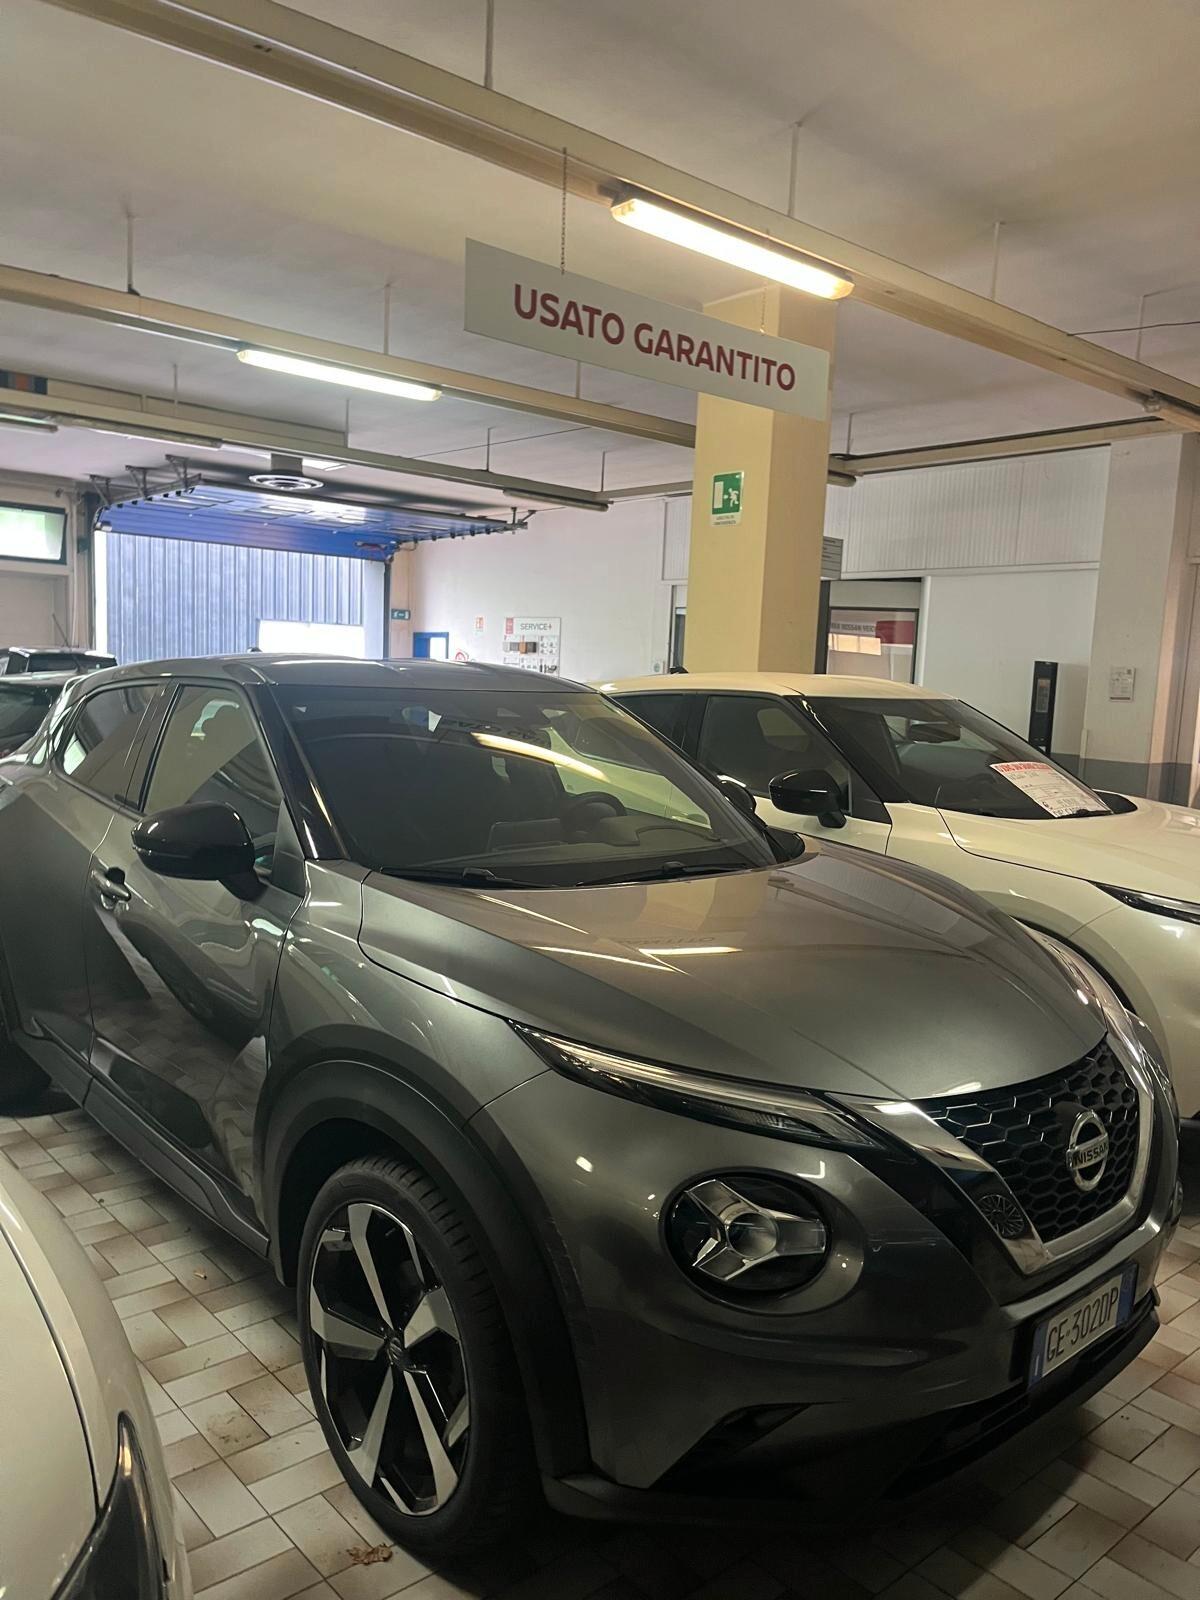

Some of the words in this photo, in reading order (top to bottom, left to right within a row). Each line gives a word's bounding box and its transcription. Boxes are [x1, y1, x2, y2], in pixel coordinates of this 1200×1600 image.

[514, 283, 625, 346] USATO
[634, 322, 796, 391] GARANTITO
[520, 623, 552, 631] SERVICE+
[1072, 1142, 1107, 1169] NISSAN
